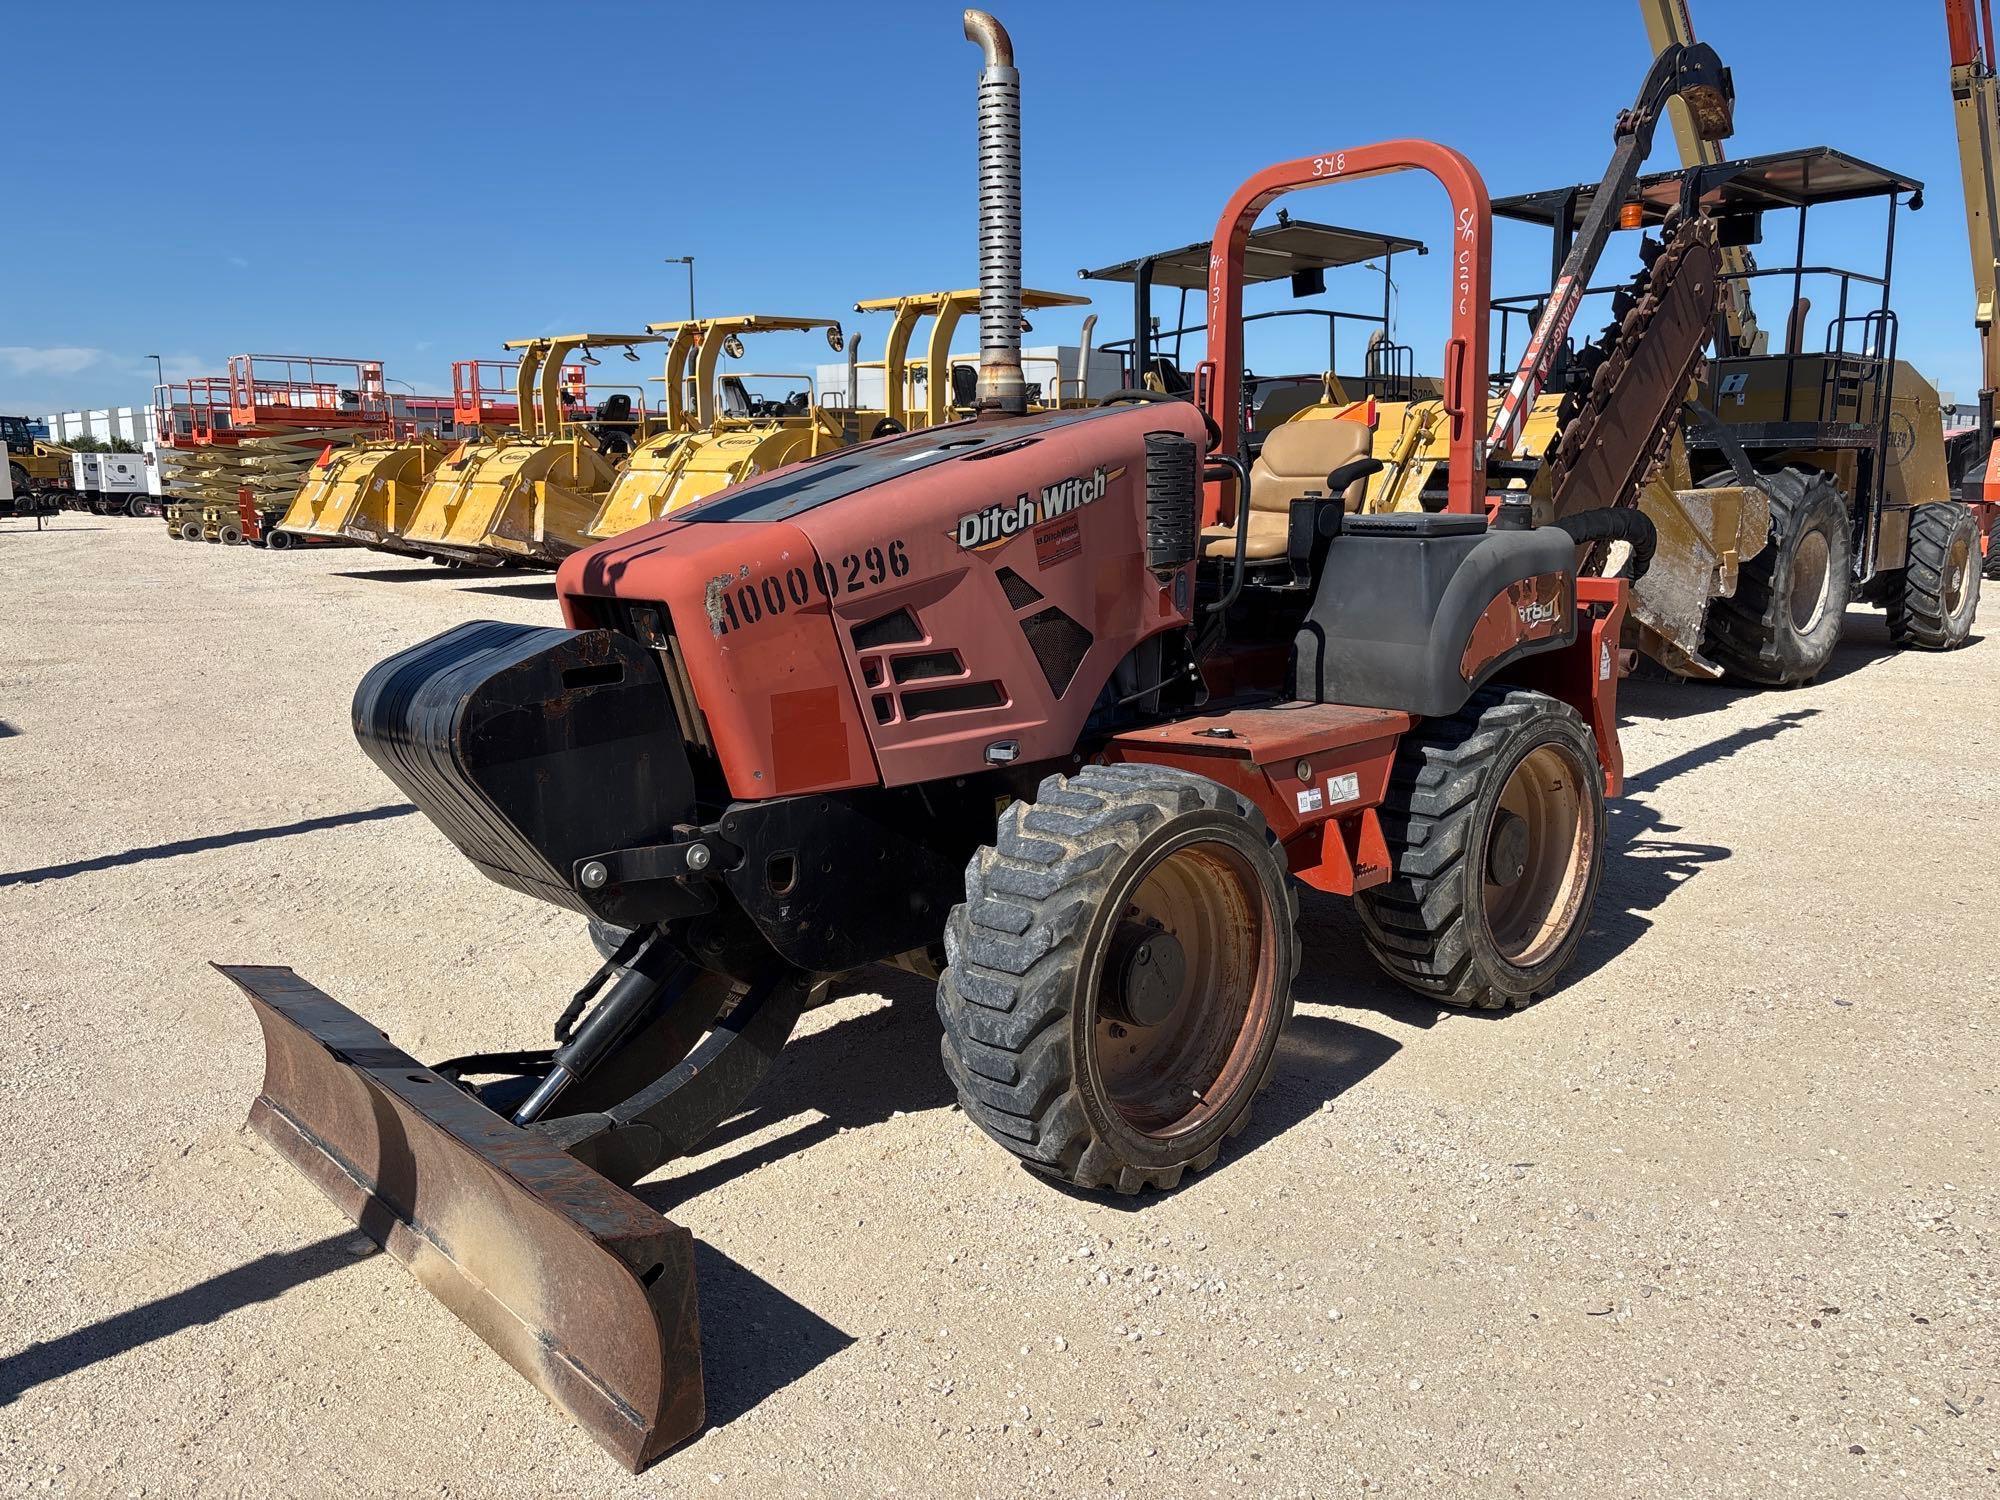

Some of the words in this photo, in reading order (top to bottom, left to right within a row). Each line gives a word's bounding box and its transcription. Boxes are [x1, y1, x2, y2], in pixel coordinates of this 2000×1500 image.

[1312, 153, 1346, 176] 348
[1459, 249, 1470, 315] 0296
[958, 495, 1036, 548] Ditch
[1041, 466, 1106, 520] Witch
